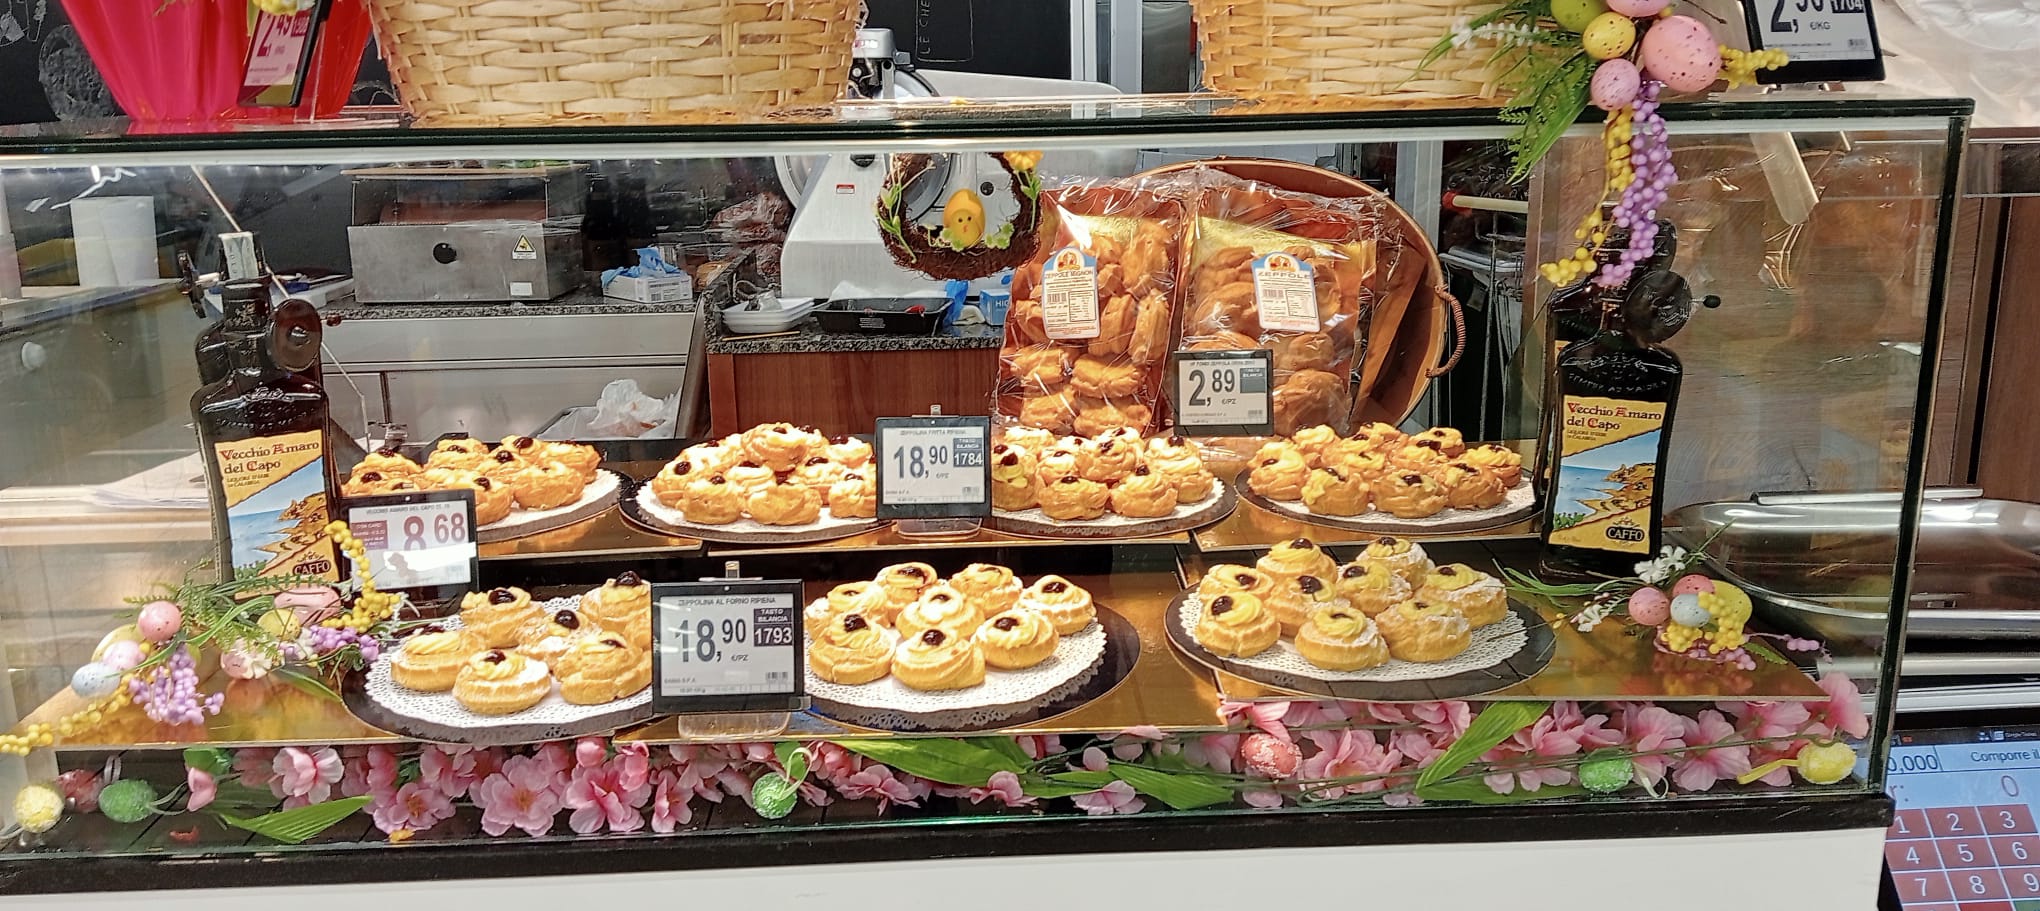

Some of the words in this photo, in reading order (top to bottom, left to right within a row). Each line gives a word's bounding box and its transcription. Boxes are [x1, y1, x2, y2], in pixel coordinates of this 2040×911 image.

[1258, 271, 1311, 279] ZEPPOLE
[1567, 402, 1614, 417] Vecchio
[1615, 407, 1662, 420] Amaro
[1567, 416, 1585, 427] del
[1588, 417, 1621, 431] Capo
[219, 449, 271, 461] Vecchio
[272, 441, 320, 455] Amaro
[954, 452, 983, 466] 1784
[224, 463, 243, 474] del
[247, 460, 281, 473] Capo
[1607, 528, 1643, 540] CAFFO
[294, 561, 330, 575] CAFFO
[754, 627, 792, 644] 1793
[1971, 750, 2031, 763] Comporre
[2001, 775, 2019, 797] 0
[1895, 815, 1910, 834] 1
[1946, 813, 1964, 831] 2
[1999, 810, 2016, 829] 3
[1906, 846, 1921, 865] 4
[1957, 844, 1974, 862] 5
[2012, 841, 2028, 860] 6
[1914, 877, 1927, 897] 7
[1969, 875, 1986, 894] 8
[2023, 873, 2040, 892] 9
